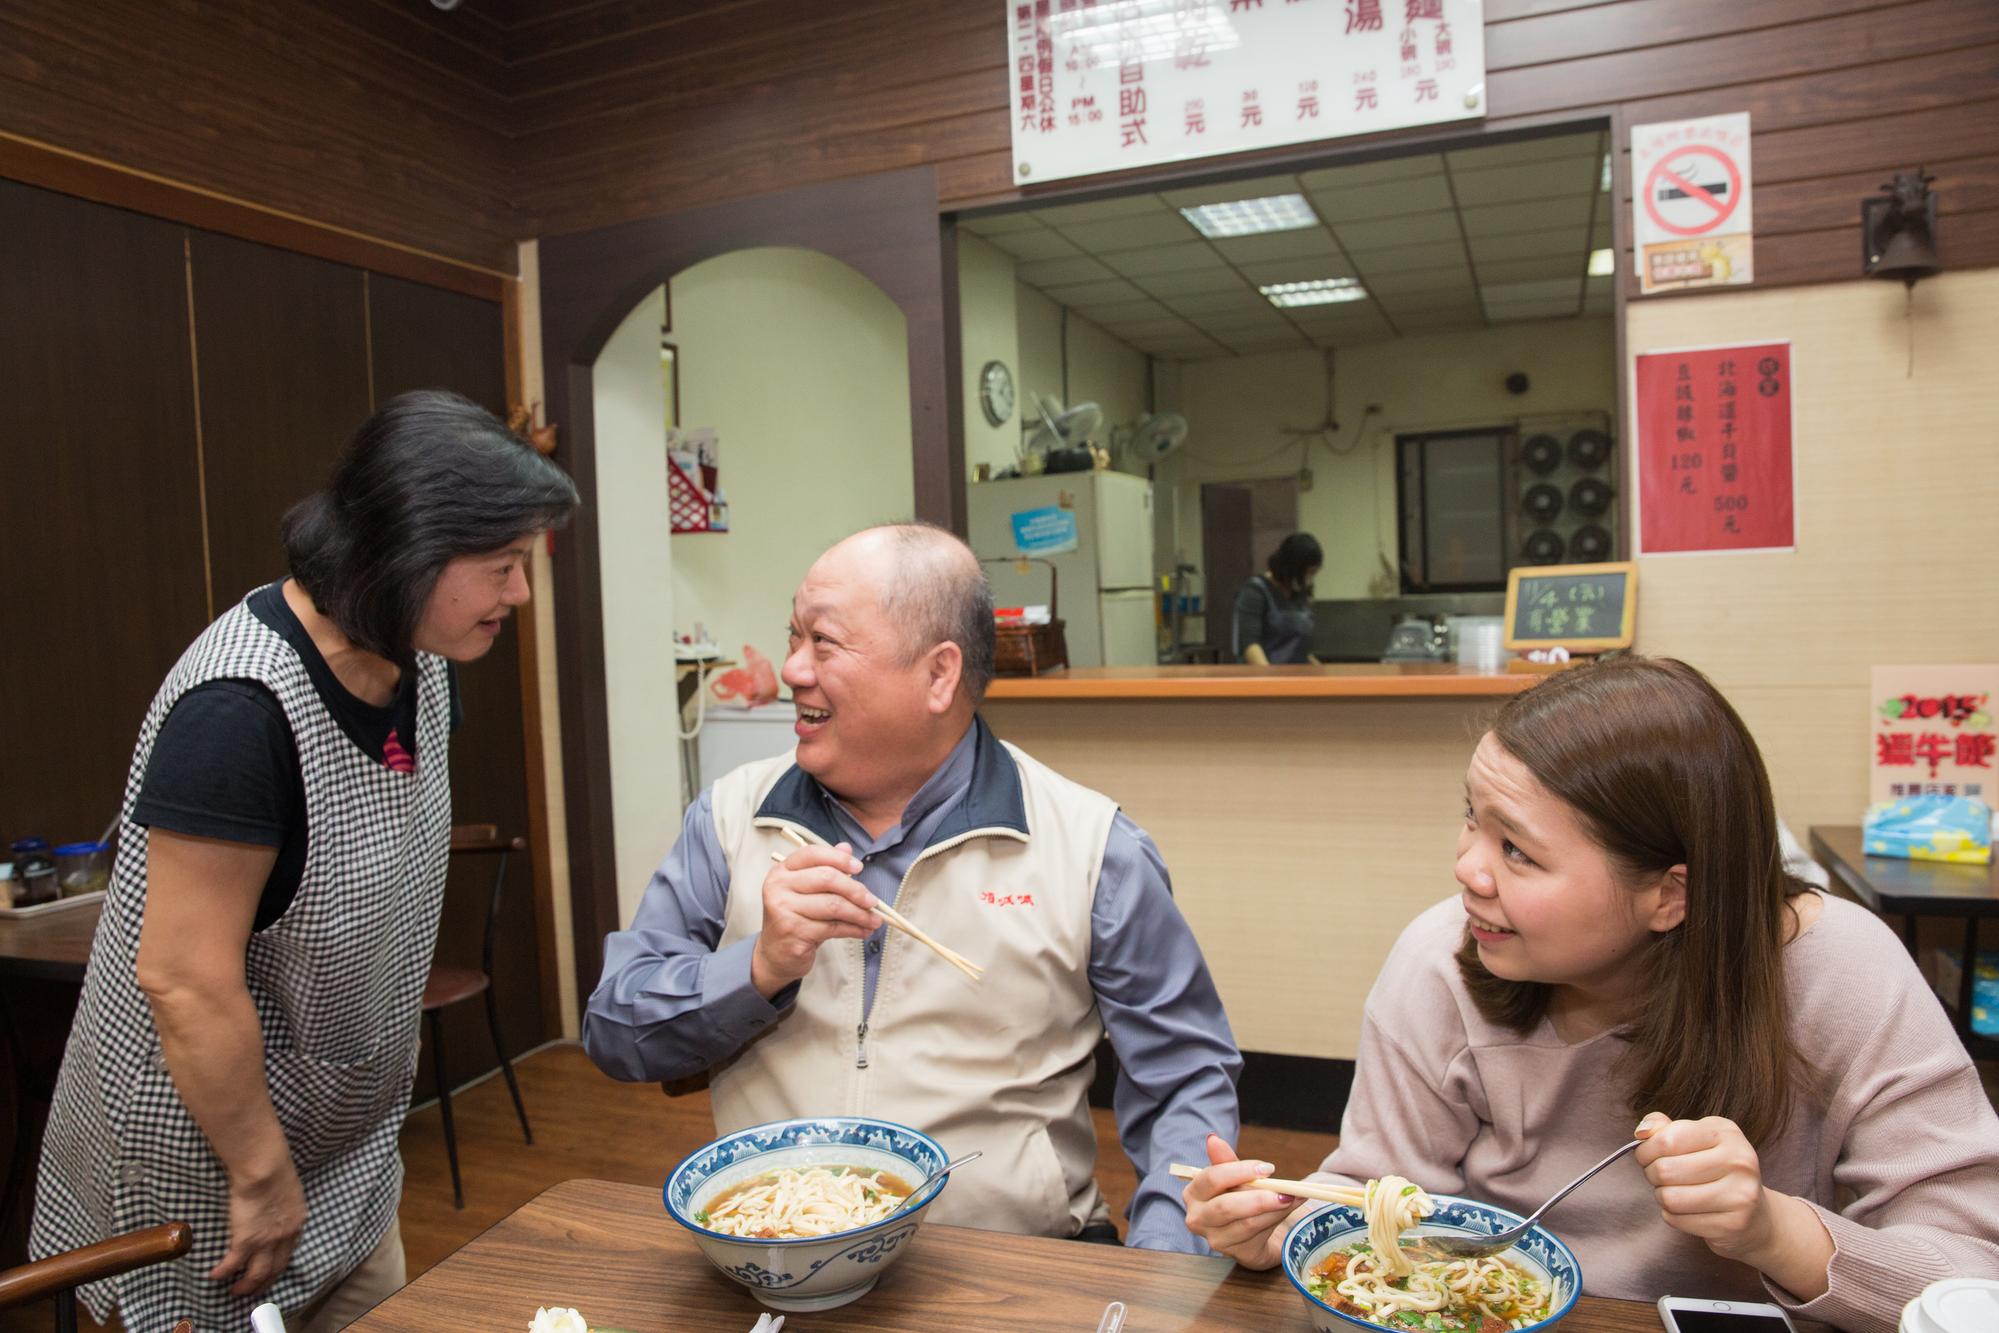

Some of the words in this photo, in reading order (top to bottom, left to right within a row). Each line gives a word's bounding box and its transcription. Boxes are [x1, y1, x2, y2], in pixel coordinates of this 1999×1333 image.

[1354, 87, 1378, 112] 元
[1416, 79, 1439, 103] 元
[1241, 105, 1262, 128] 元
[1297, 96, 1319, 120] 元
[1185, 113, 1206, 135] 元
